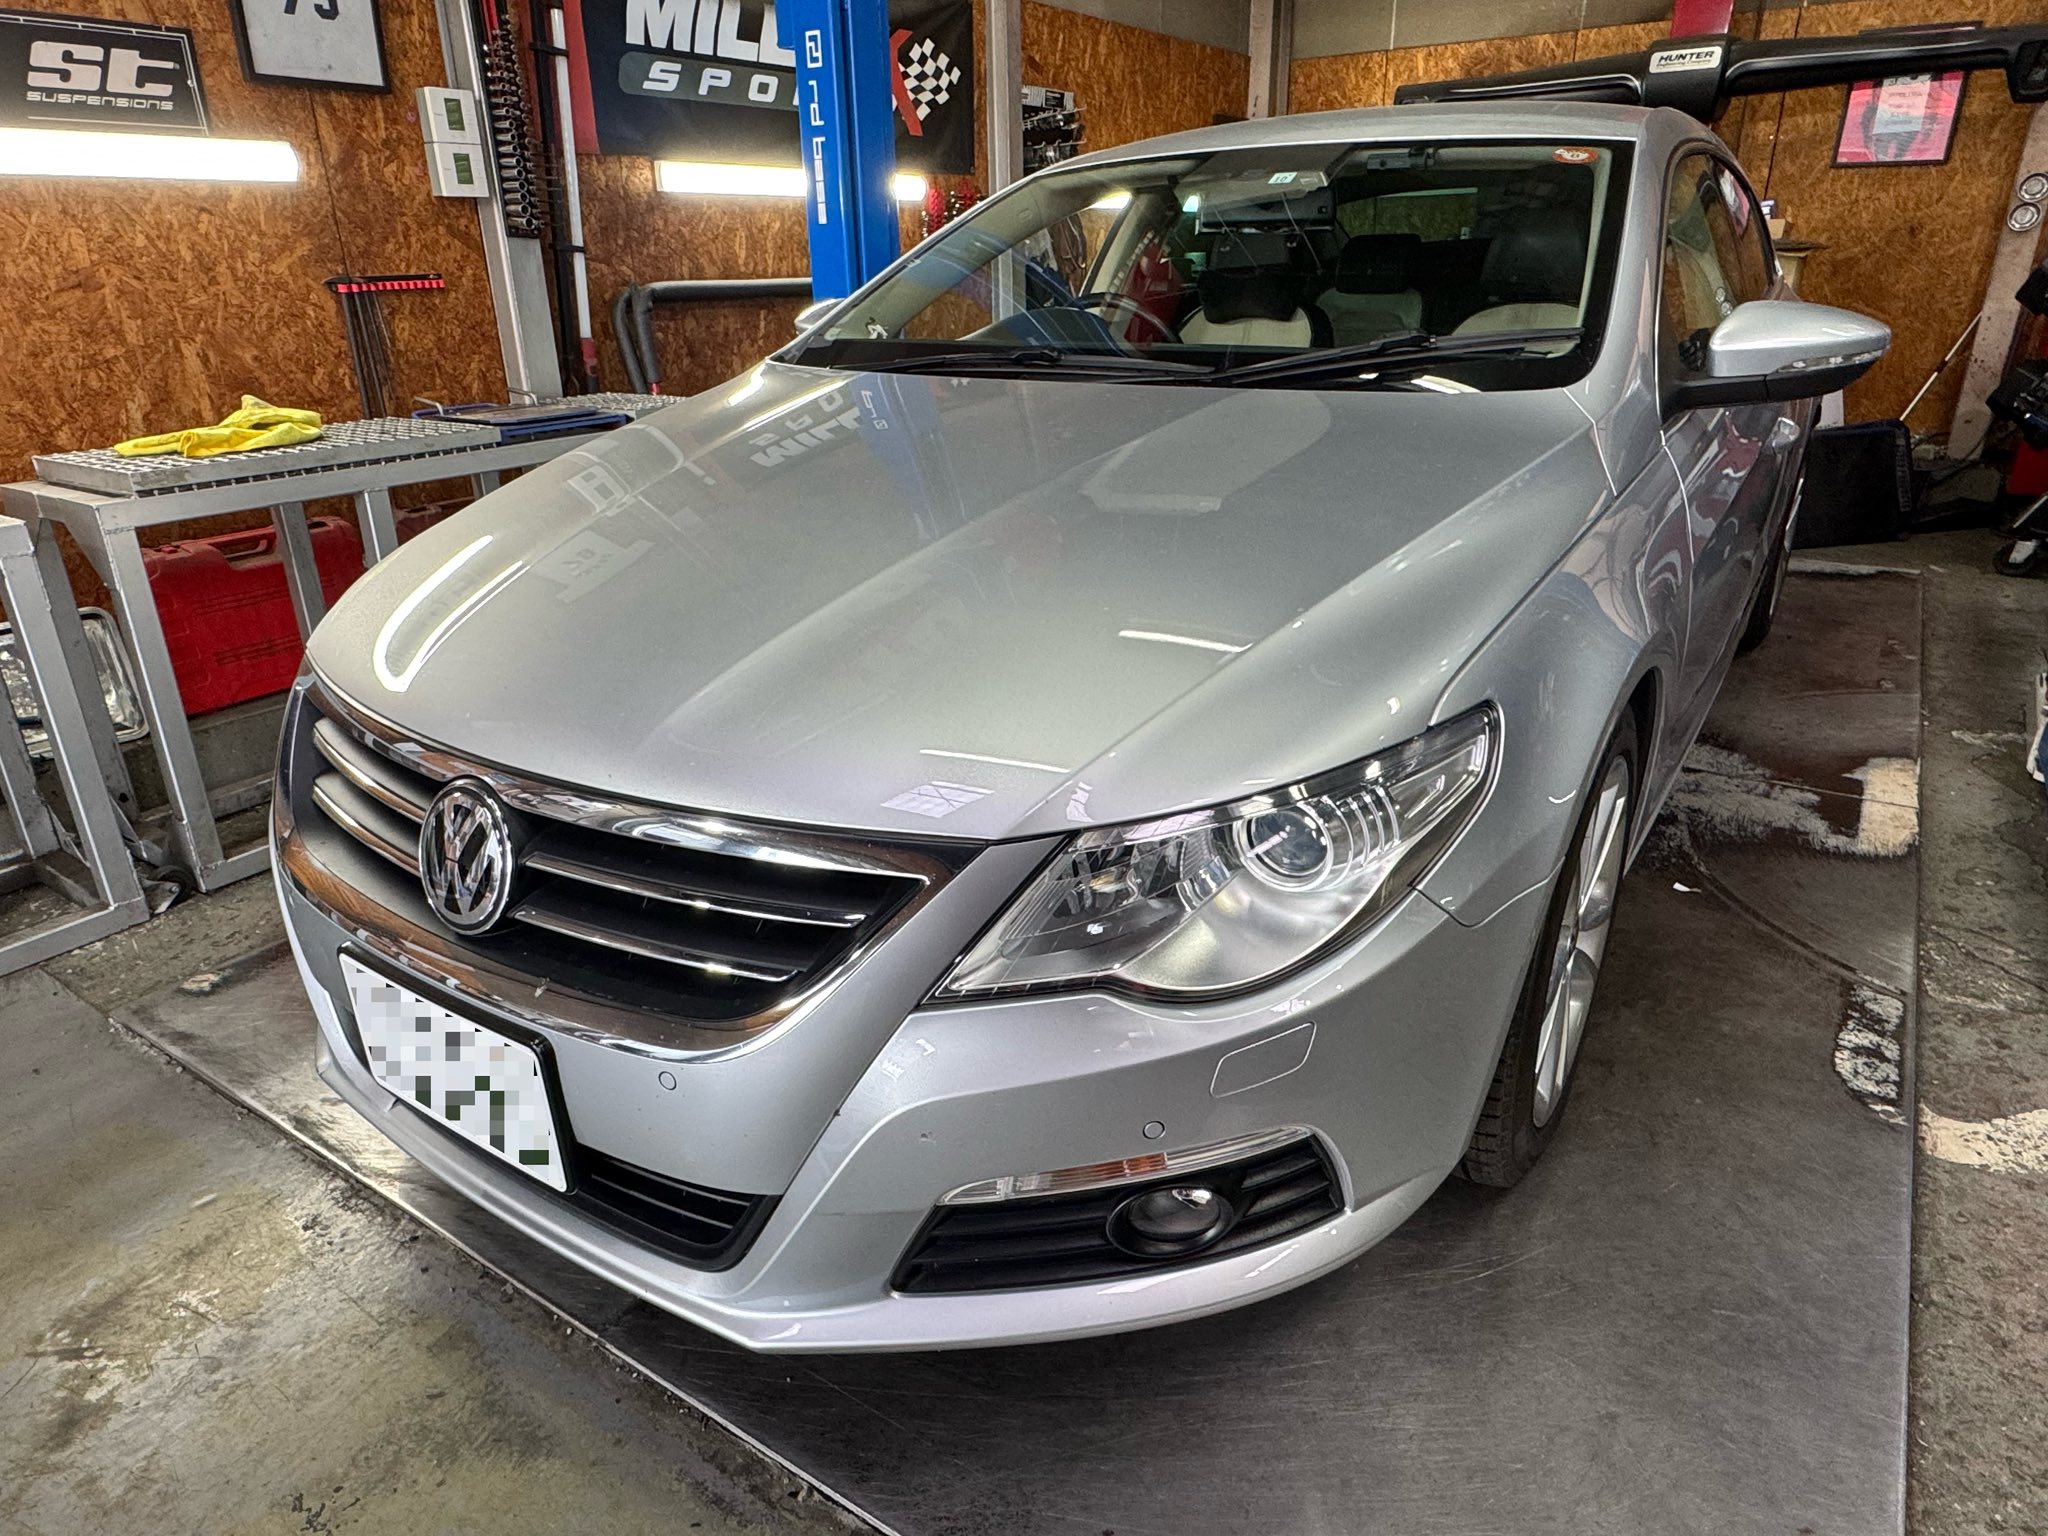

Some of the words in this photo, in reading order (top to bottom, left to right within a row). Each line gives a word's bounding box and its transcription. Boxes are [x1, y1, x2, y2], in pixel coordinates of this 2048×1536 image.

[1658, 51, 1715, 63] HUNTER
[643, 61, 799, 105] SPO
[26, 91, 174, 110] SUSPENSIONS
